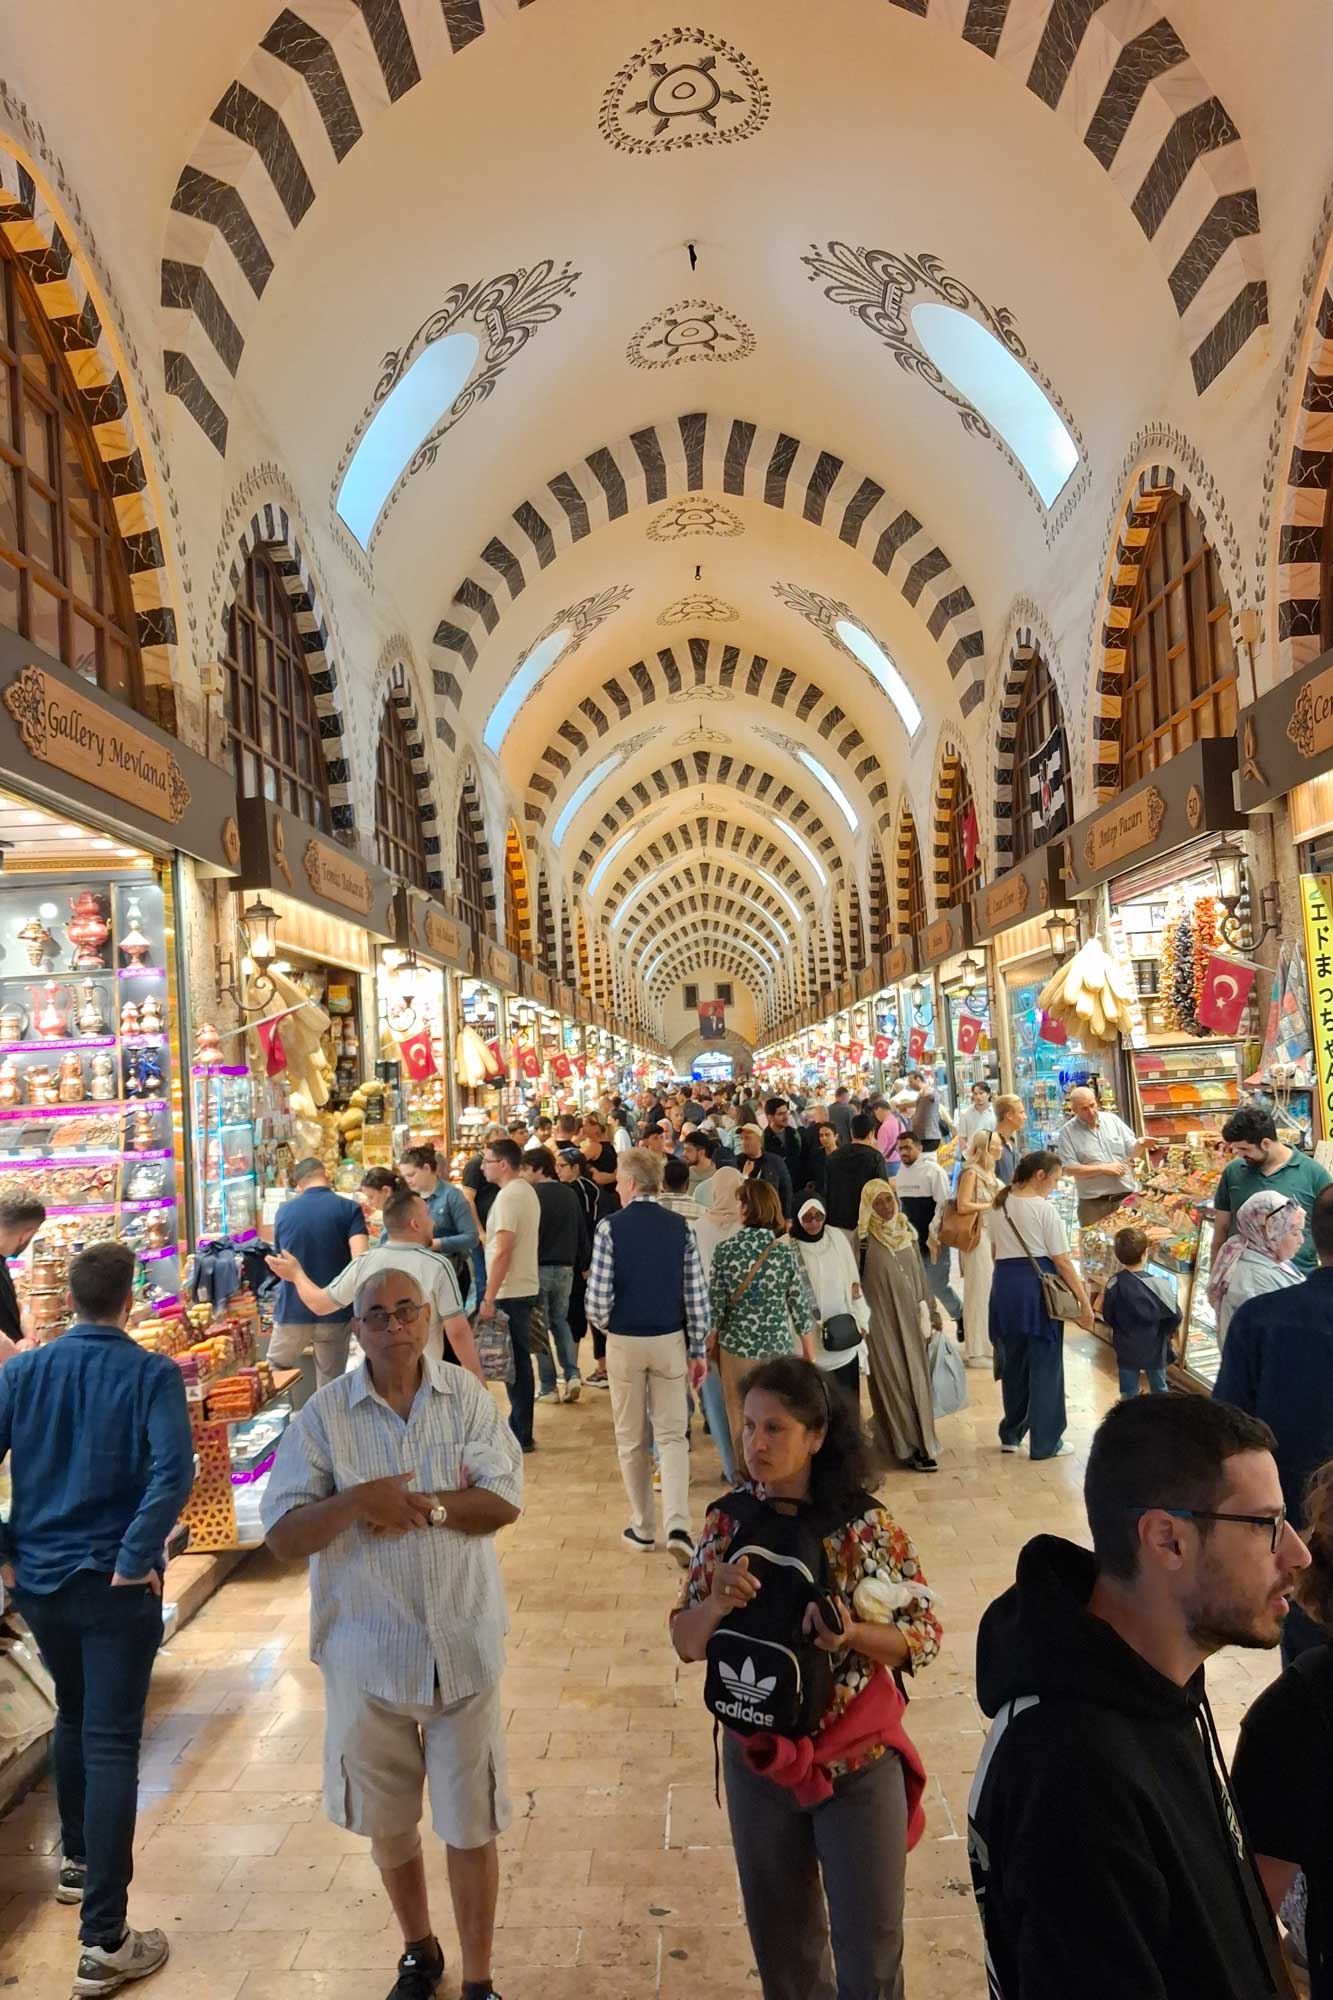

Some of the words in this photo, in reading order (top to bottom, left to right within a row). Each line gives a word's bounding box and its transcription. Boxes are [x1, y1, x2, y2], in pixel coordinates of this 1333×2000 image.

[1314, 695, 1333, 724] Ce
[48, 702, 105, 767] Gallery
[109, 738, 167, 791] Mevlana
[1188, 797, 1198, 817] 50
[1099, 825, 1118, 849] Antep
[715, 1700, 775, 1727] adidas
